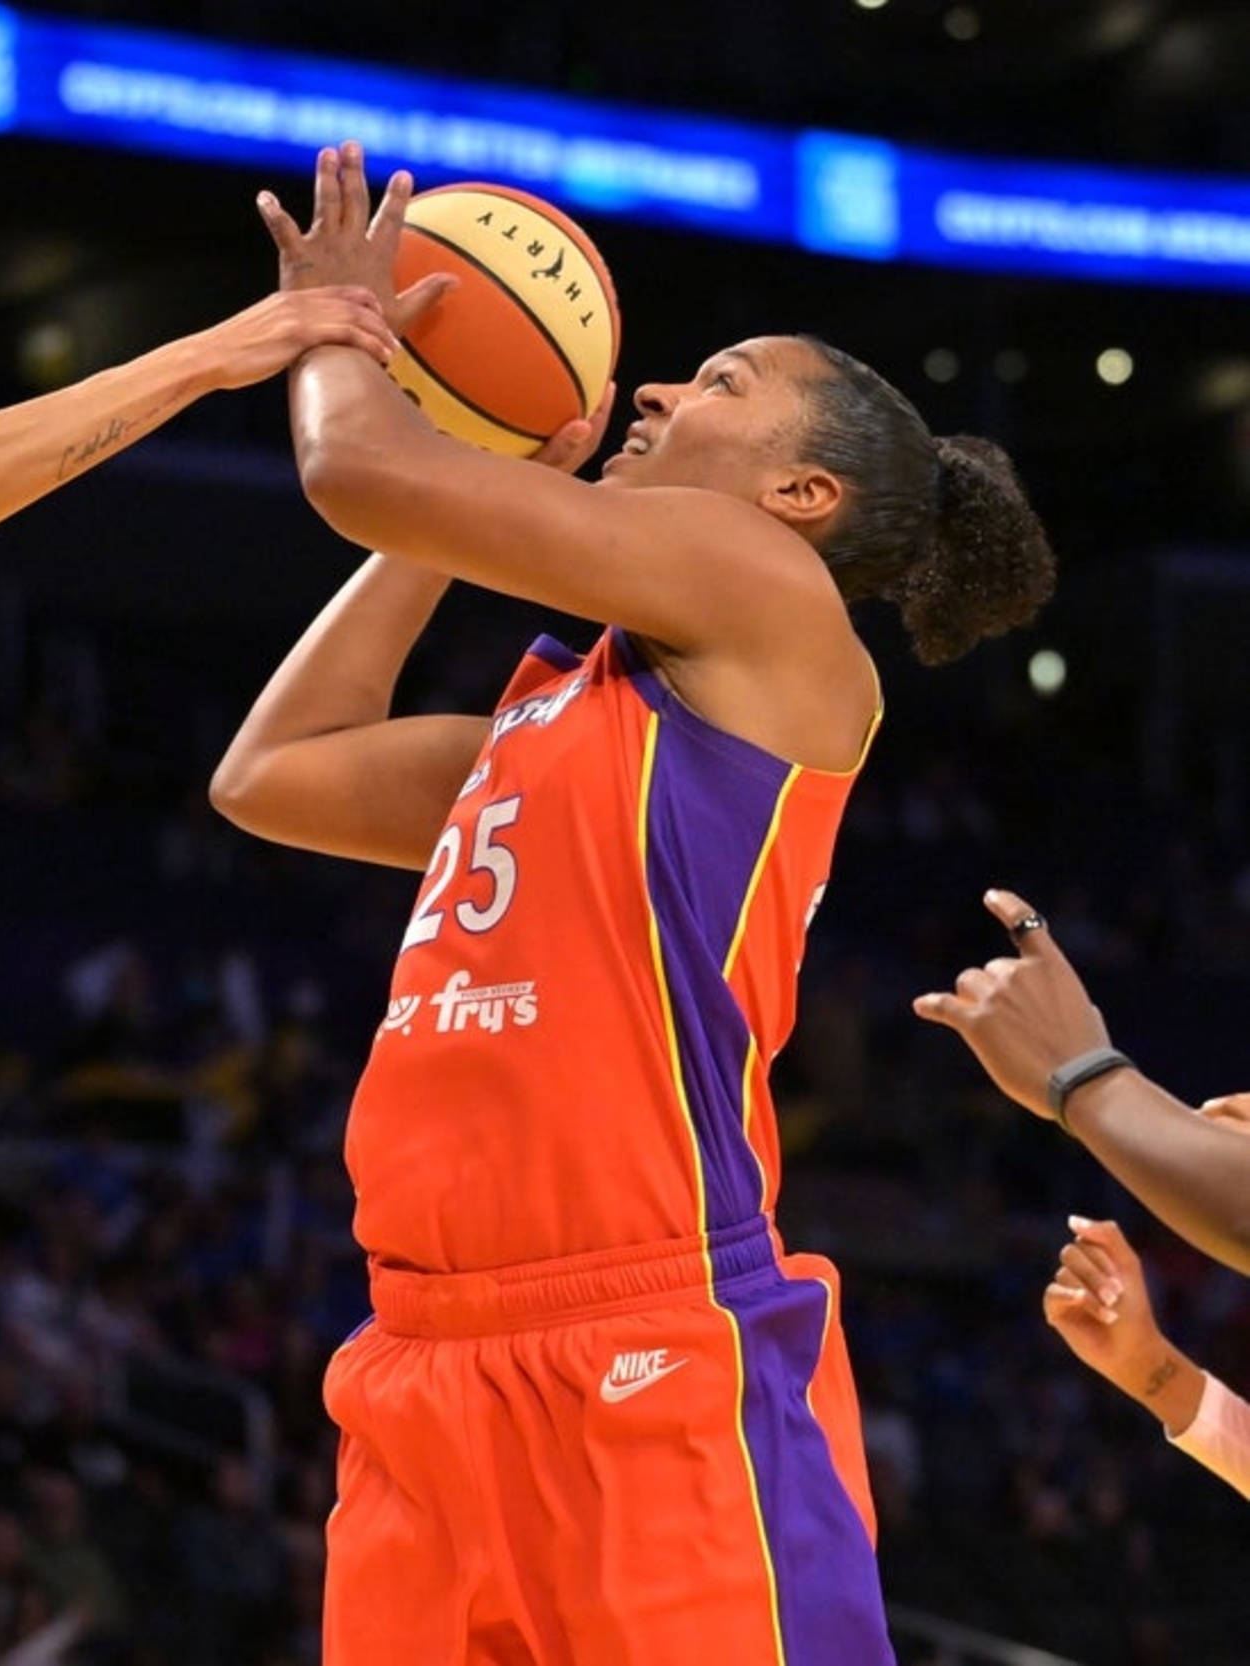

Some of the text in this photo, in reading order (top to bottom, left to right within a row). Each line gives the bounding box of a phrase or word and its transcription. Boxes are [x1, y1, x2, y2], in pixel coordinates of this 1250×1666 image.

[400, 794, 522, 955] 25
[429, 969, 538, 1034] fry's
[611, 1348, 669, 1381] NIKE
